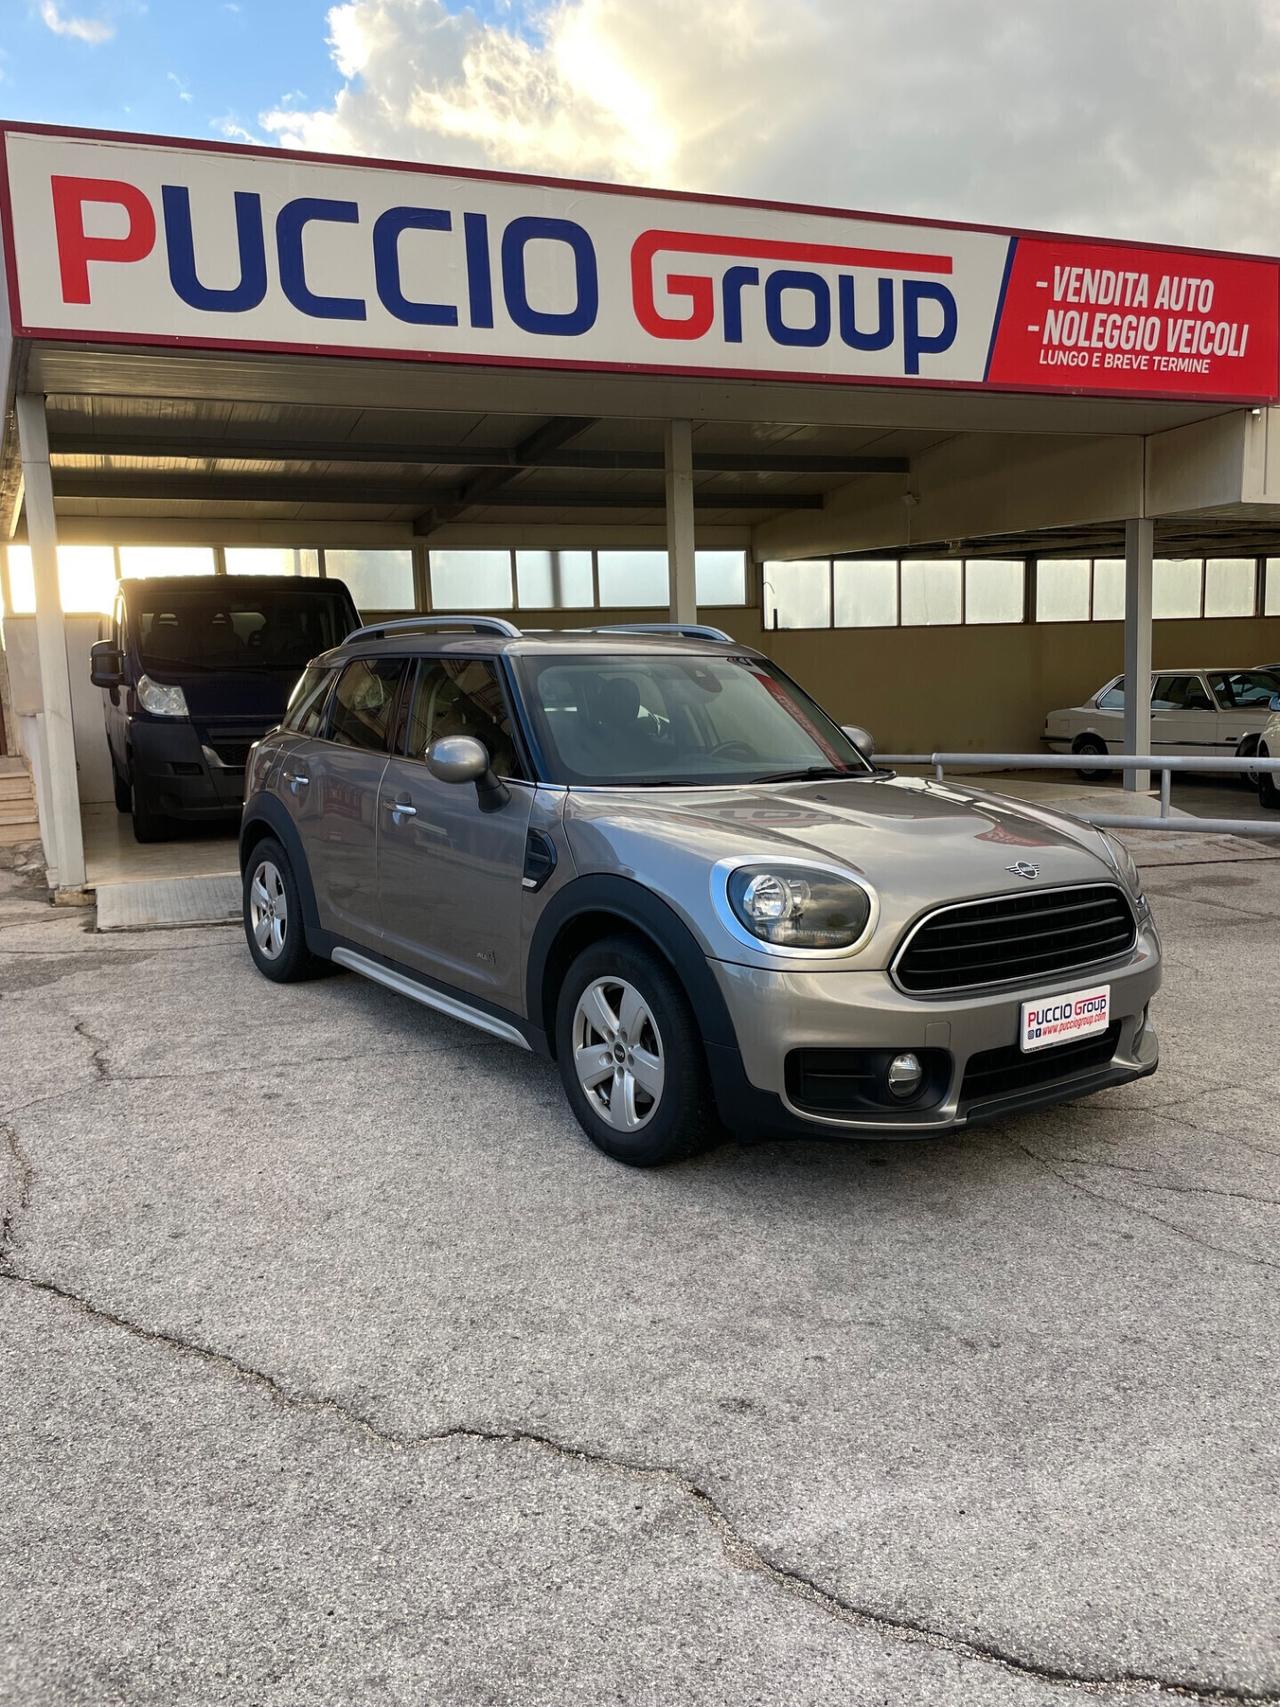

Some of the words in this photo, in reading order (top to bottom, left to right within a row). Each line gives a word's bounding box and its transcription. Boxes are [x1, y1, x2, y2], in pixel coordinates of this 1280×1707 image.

[51, 175, 598, 335] PUCCIO
[630, 229, 957, 374] Group
[1053, 265, 1149, 308] VENDITA
[1153, 275, 1214, 314] AUTO
[1042, 309, 1161, 352] NOLEGGIO
[1166, 318, 1249, 358] VEICOLI
[1039, 349, 1089, 367] LUNGO
[1091, 352, 1102, 368] E
[1104, 353, 1150, 370] BREVE
[1152, 356, 1211, 374] TERMINE
[1028, 1003, 1072, 1027] PUCCIO
[1074, 995, 1107, 1016] Group
[1042, 1012, 1107, 1035] www.pucciogroup.com
